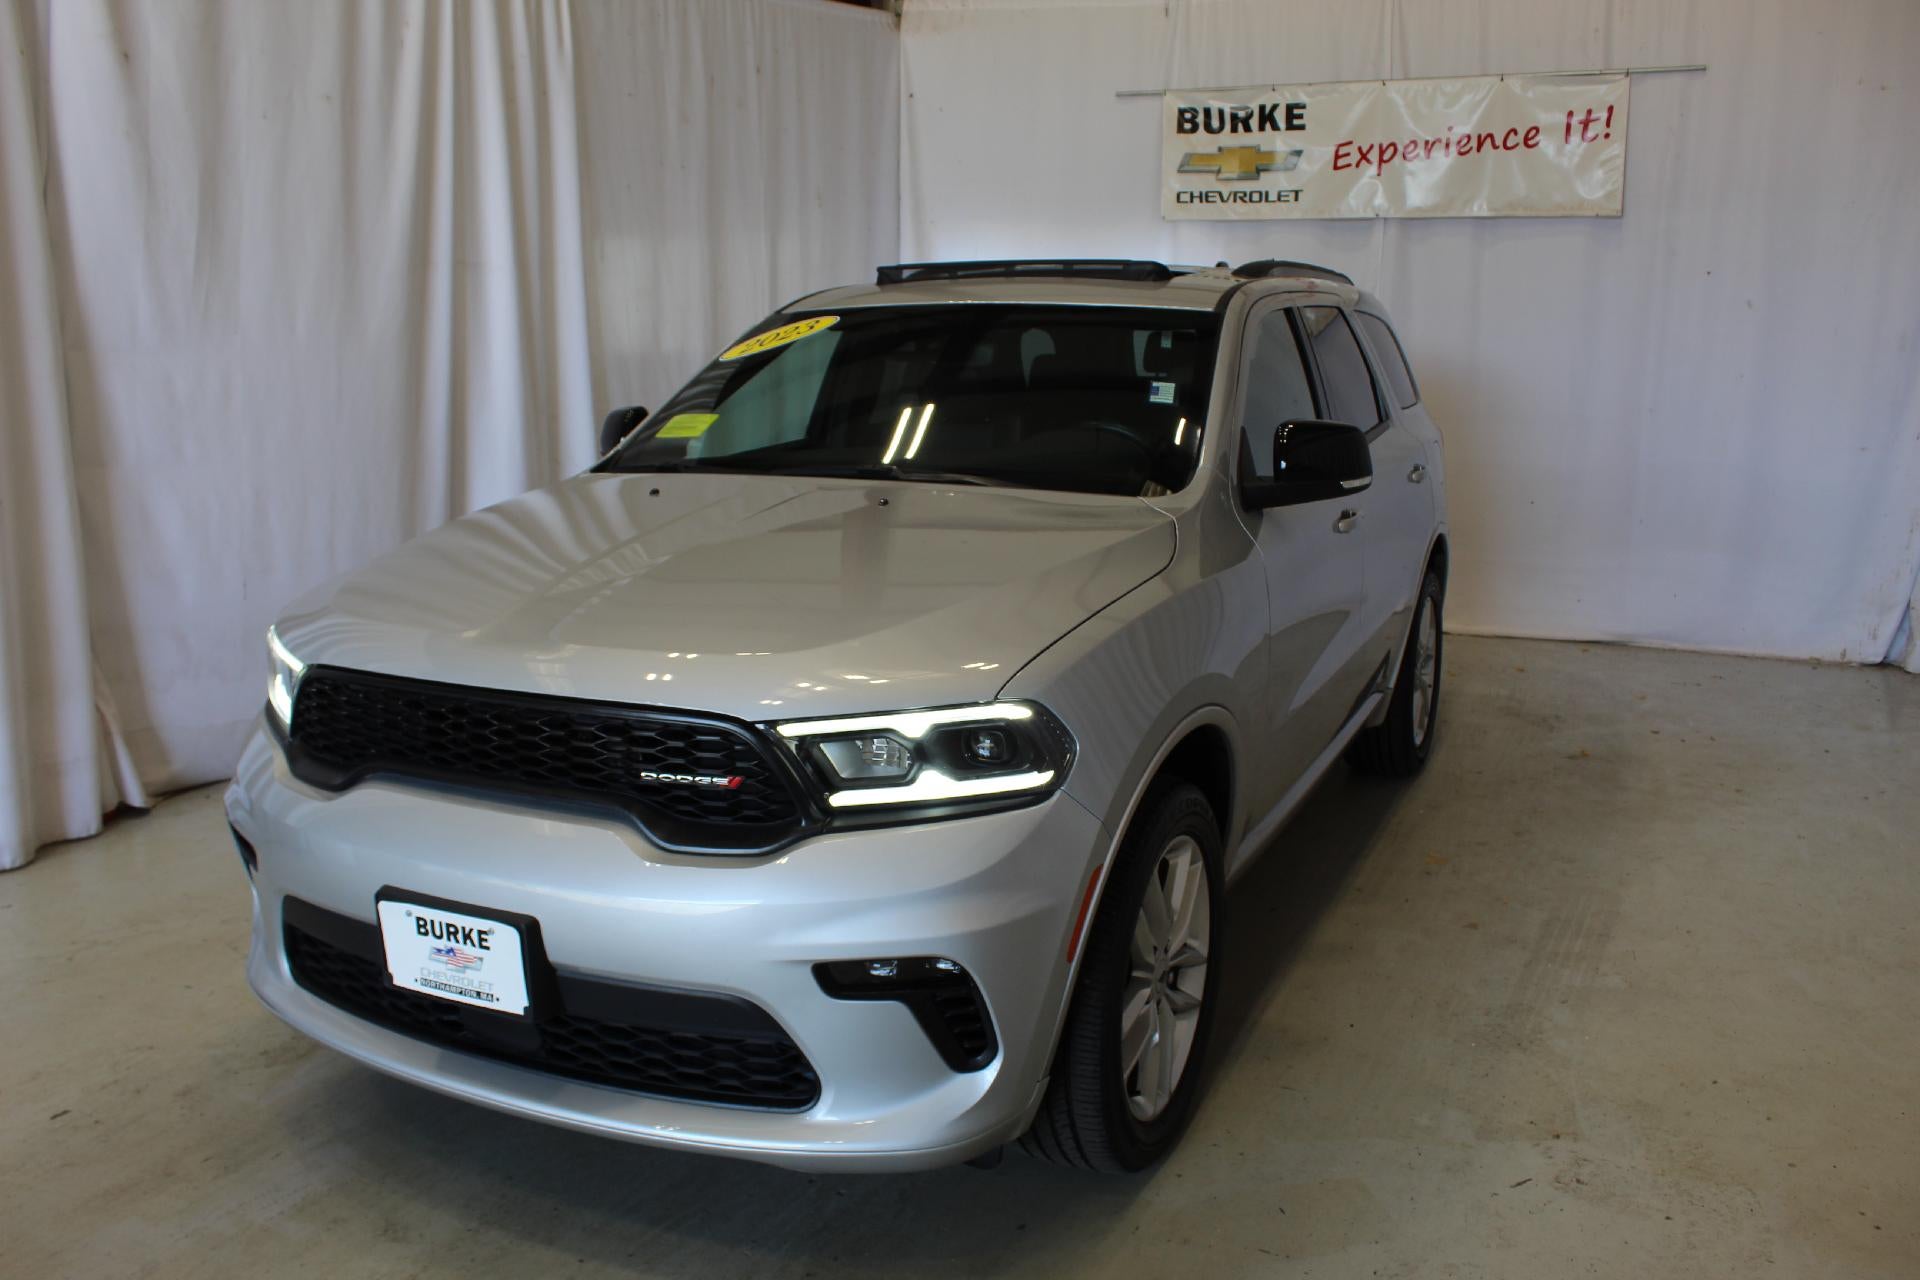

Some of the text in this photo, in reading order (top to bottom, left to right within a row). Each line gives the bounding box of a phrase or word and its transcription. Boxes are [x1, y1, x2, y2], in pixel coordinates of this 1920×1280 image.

[1177, 103, 1306, 134] BURKE
[1332, 105, 1614, 176] Experience It!
[1176, 190, 1303, 203] CHEVROLET
[738, 319, 820, 354] 2023
[640, 772, 729, 785] DODGE
[416, 916, 490, 950] BURKE
[420, 967, 494, 992] CHEVROLET
